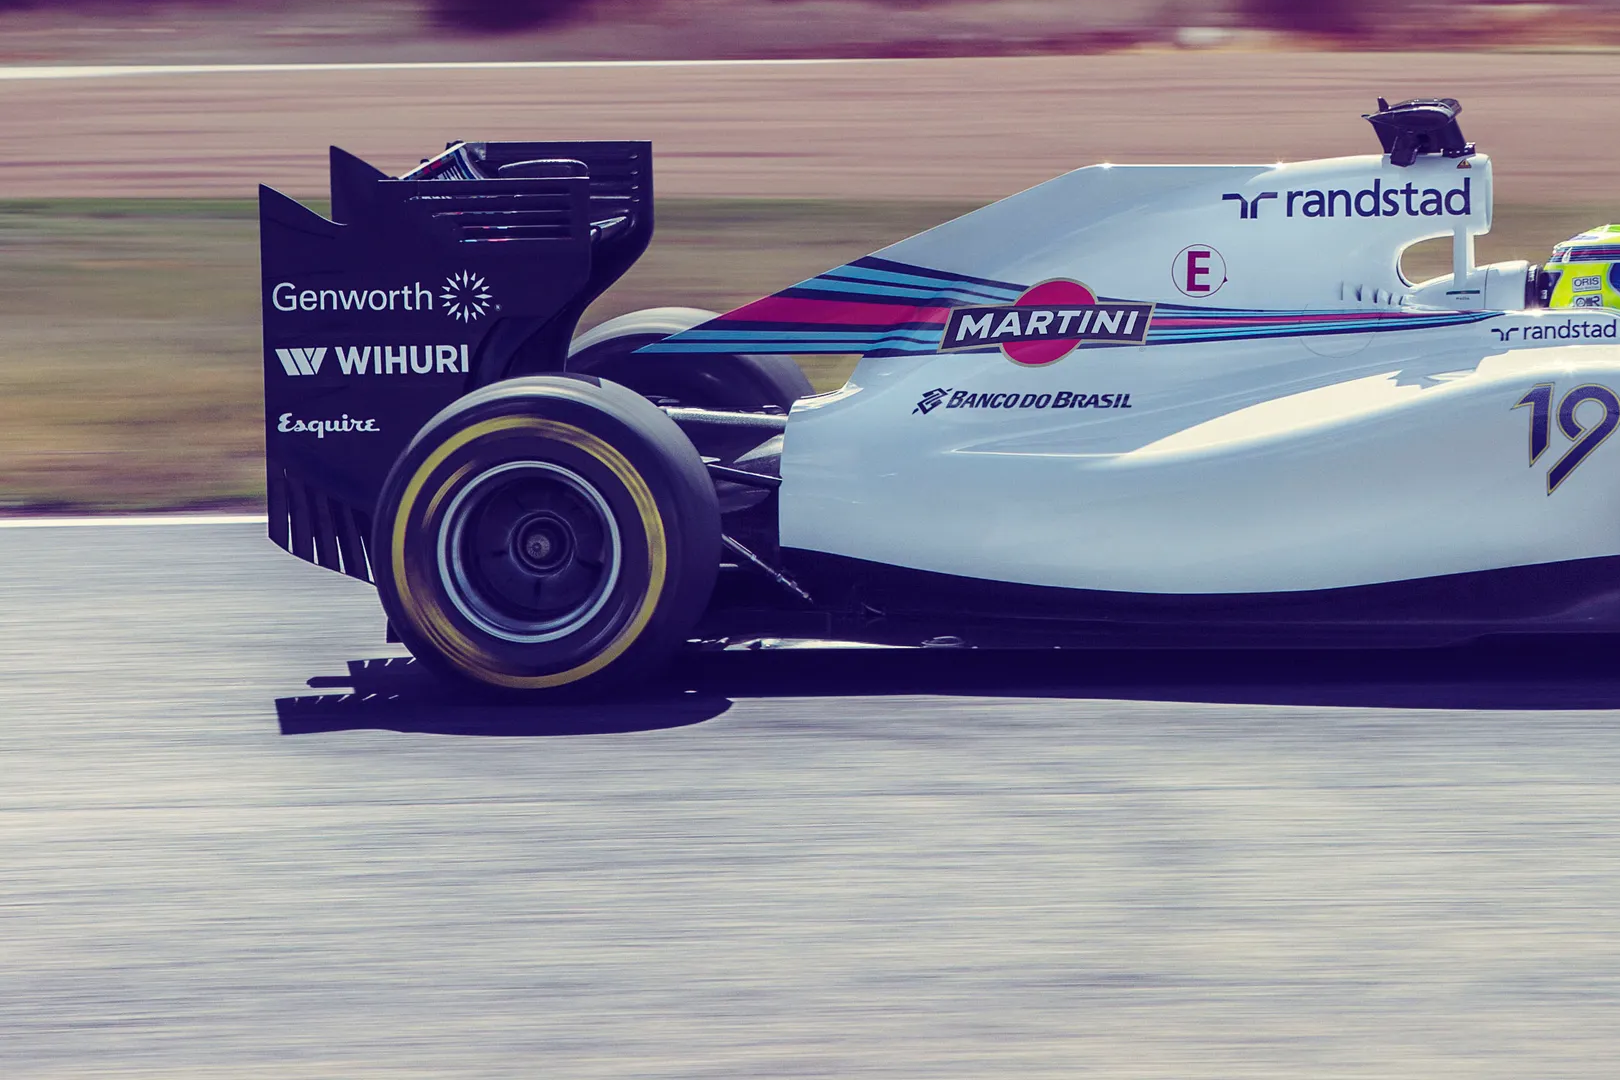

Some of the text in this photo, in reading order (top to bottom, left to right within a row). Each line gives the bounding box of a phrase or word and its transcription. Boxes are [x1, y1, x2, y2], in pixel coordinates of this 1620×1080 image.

[1286, 177, 1471, 217] randstad
[1187, 251, 1210, 291] E
[1574, 277, 1599, 287] ORIS
[272, 282, 433, 311] Genworth
[955, 310, 1139, 341] MARTINI
[1523, 319, 1617, 340] randstad
[335, 344, 469, 374] WIHURI
[946, 391, 1132, 408] BANCO DO BRASIL
[278, 413, 380, 438] Esquire
